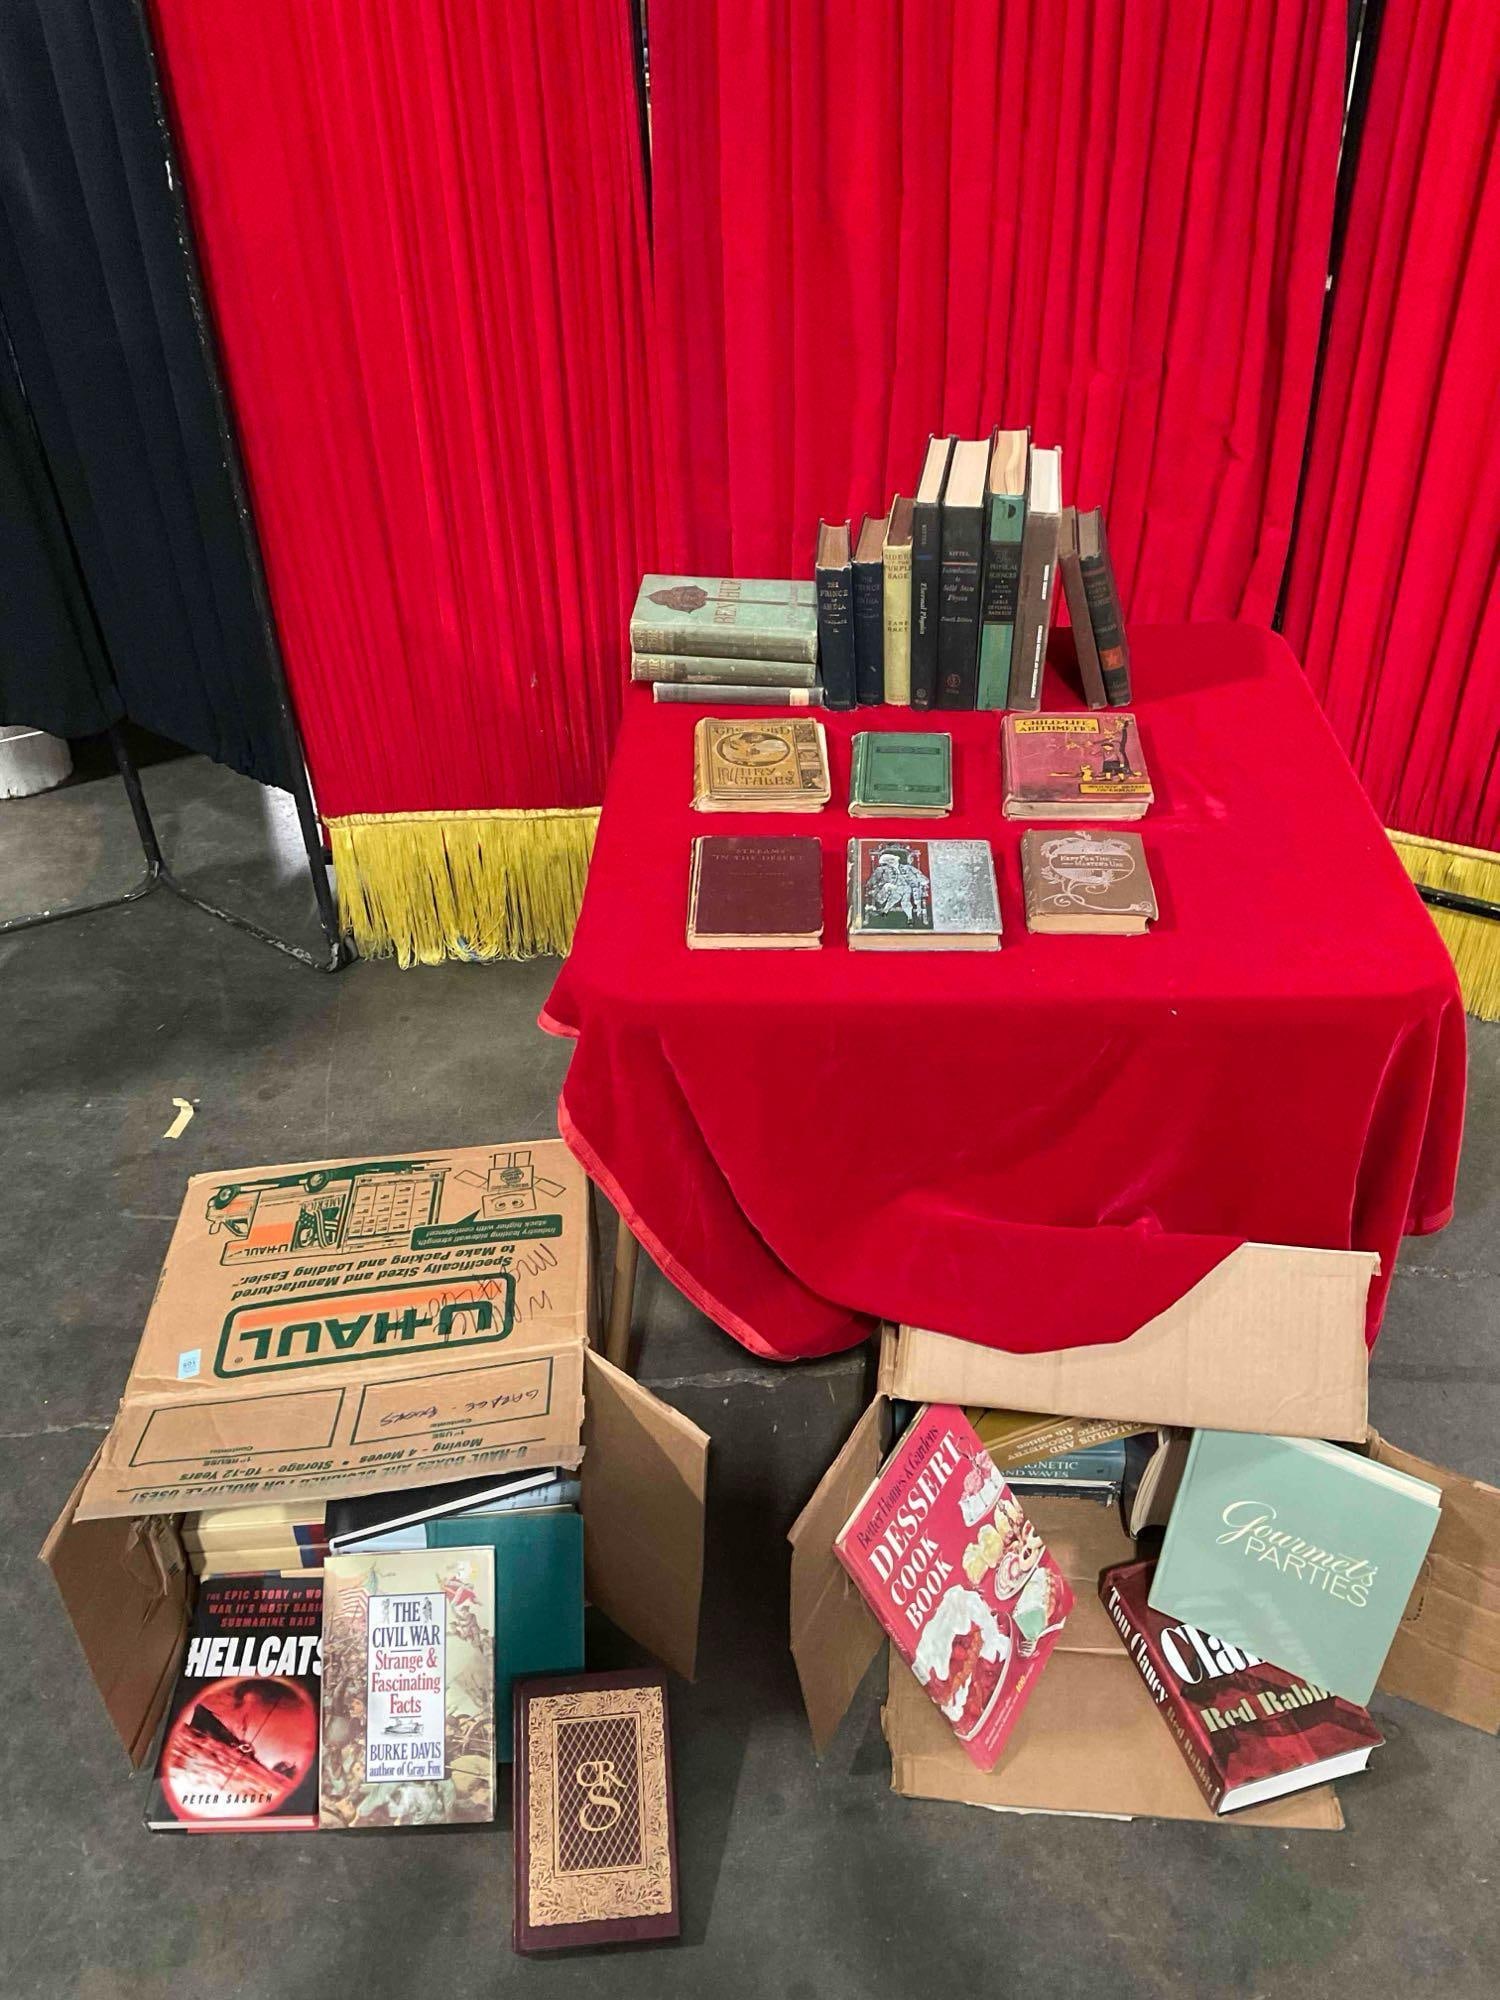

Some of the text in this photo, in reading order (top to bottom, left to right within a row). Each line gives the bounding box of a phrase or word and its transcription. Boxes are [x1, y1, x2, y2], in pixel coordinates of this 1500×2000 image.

[820, 589, 848, 597] PRINCE
[713, 580, 743, 624] BEN HUR
[918, 582, 928, 635] Thermal Physics
[740, 770, 795, 785] TALES
[391, 1250, 451, 1265] Packing
[454, 1246, 499, 1257] Make
[501, 1244, 516, 1254] to
[293, 1261, 355, 1277] Loading
[357, 1257, 387, 1271] and
[231, 1256, 513, 1301] Specifically Sized and Manufactured
[239, 1300, 493, 1361] U-HAUL
[465, 1389, 539, 1412] GARAGE
[432, 1431, 453, 1440] USE
[1055, 1425, 1075, 1437] 4th
[433, 1438, 483, 1451] Moving
[1050, 1441, 1076, 1455] AND
[203, 1457, 237, 1467] REUSE
[357, 1450, 404, 1464] Moves
[222, 1466, 262, 1479] 10-12
[278, 1460, 334, 1473] Storage
[1027, 1470, 1069, 1478] WAVES
[179, 1470, 218, 1481] Years
[856, 1508, 882, 1550] Better
[881, 1475, 907, 1519] Homes
[908, 1426, 940, 1470] Gardens
[868, 1430, 964, 1585] DESSERT
[1215, 1500, 1379, 1588] Gourmet's
[890, 1528, 939, 1606] COOK
[1244, 1536, 1369, 1607] PARTIES
[224, 1590, 250, 1600] EPIC
[253, 1589, 289, 1600] STORY
[904, 1552, 954, 1631] BOOK
[208, 1604, 231, 1614] WAR
[259, 1603, 290, 1613] MOST
[393, 1600, 421, 1623] THE
[220, 1616, 317, 1628] SUBMARINE RAID
[372, 1624, 441, 1648] CIVIL WAR
[375, 1647, 438, 1674] Strange &
[1160, 1623, 1267, 1685] Cla
[1108, 1586, 1132, 1639] Tom
[1130, 1631, 1169, 1705] Clancy
[1166, 1705, 1186, 1740] Red
[371, 1671, 441, 1694] Fascinating
[389, 1693, 422, 1714] Facts
[1200, 1682, 1334, 1733] Red Rabb
[370, 1741, 441, 1761] BURKE DAVIS
[369, 1760, 441, 1778] author of Gray Fox
[182, 1794, 219, 1804] PETER
